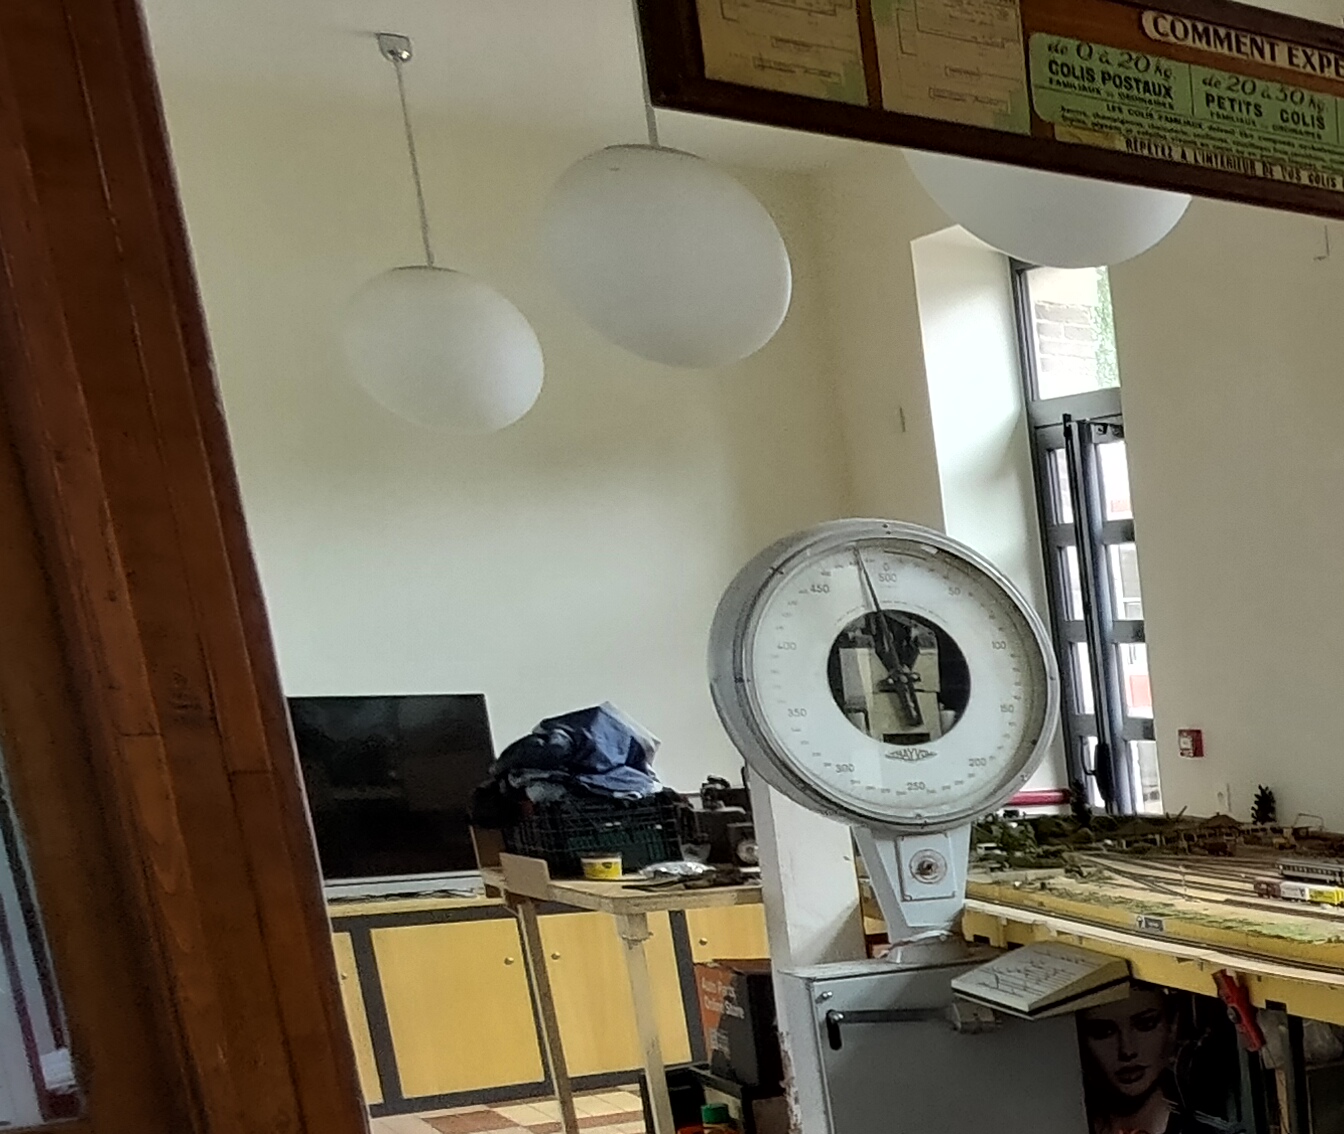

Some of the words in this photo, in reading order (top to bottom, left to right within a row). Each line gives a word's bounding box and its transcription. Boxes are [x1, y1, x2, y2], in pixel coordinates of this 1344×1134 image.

[1153, 14, 1279, 62] COMMENT
[1118, 52, 1151, 73] 20
[1048, 58, 1096, 83] COLIS
[1101, 70, 1174, 100] POSTAUX
[1225, 75, 1256, 95] 20
[1205, 92, 1263, 117] PETITS
[1280, 108, 1325, 130] COLIS
[1281, 165, 1301, 182] VOS
[1308, 171, 1336, 188] COLIS
[878, 573, 897, 582] 500
[810, 584, 830, 593] 450
[992, 640, 1007, 650] 100
[787, 708, 807, 717] 350
[968, 758, 987, 767] 200
[907, 782, 926, 791] 250
